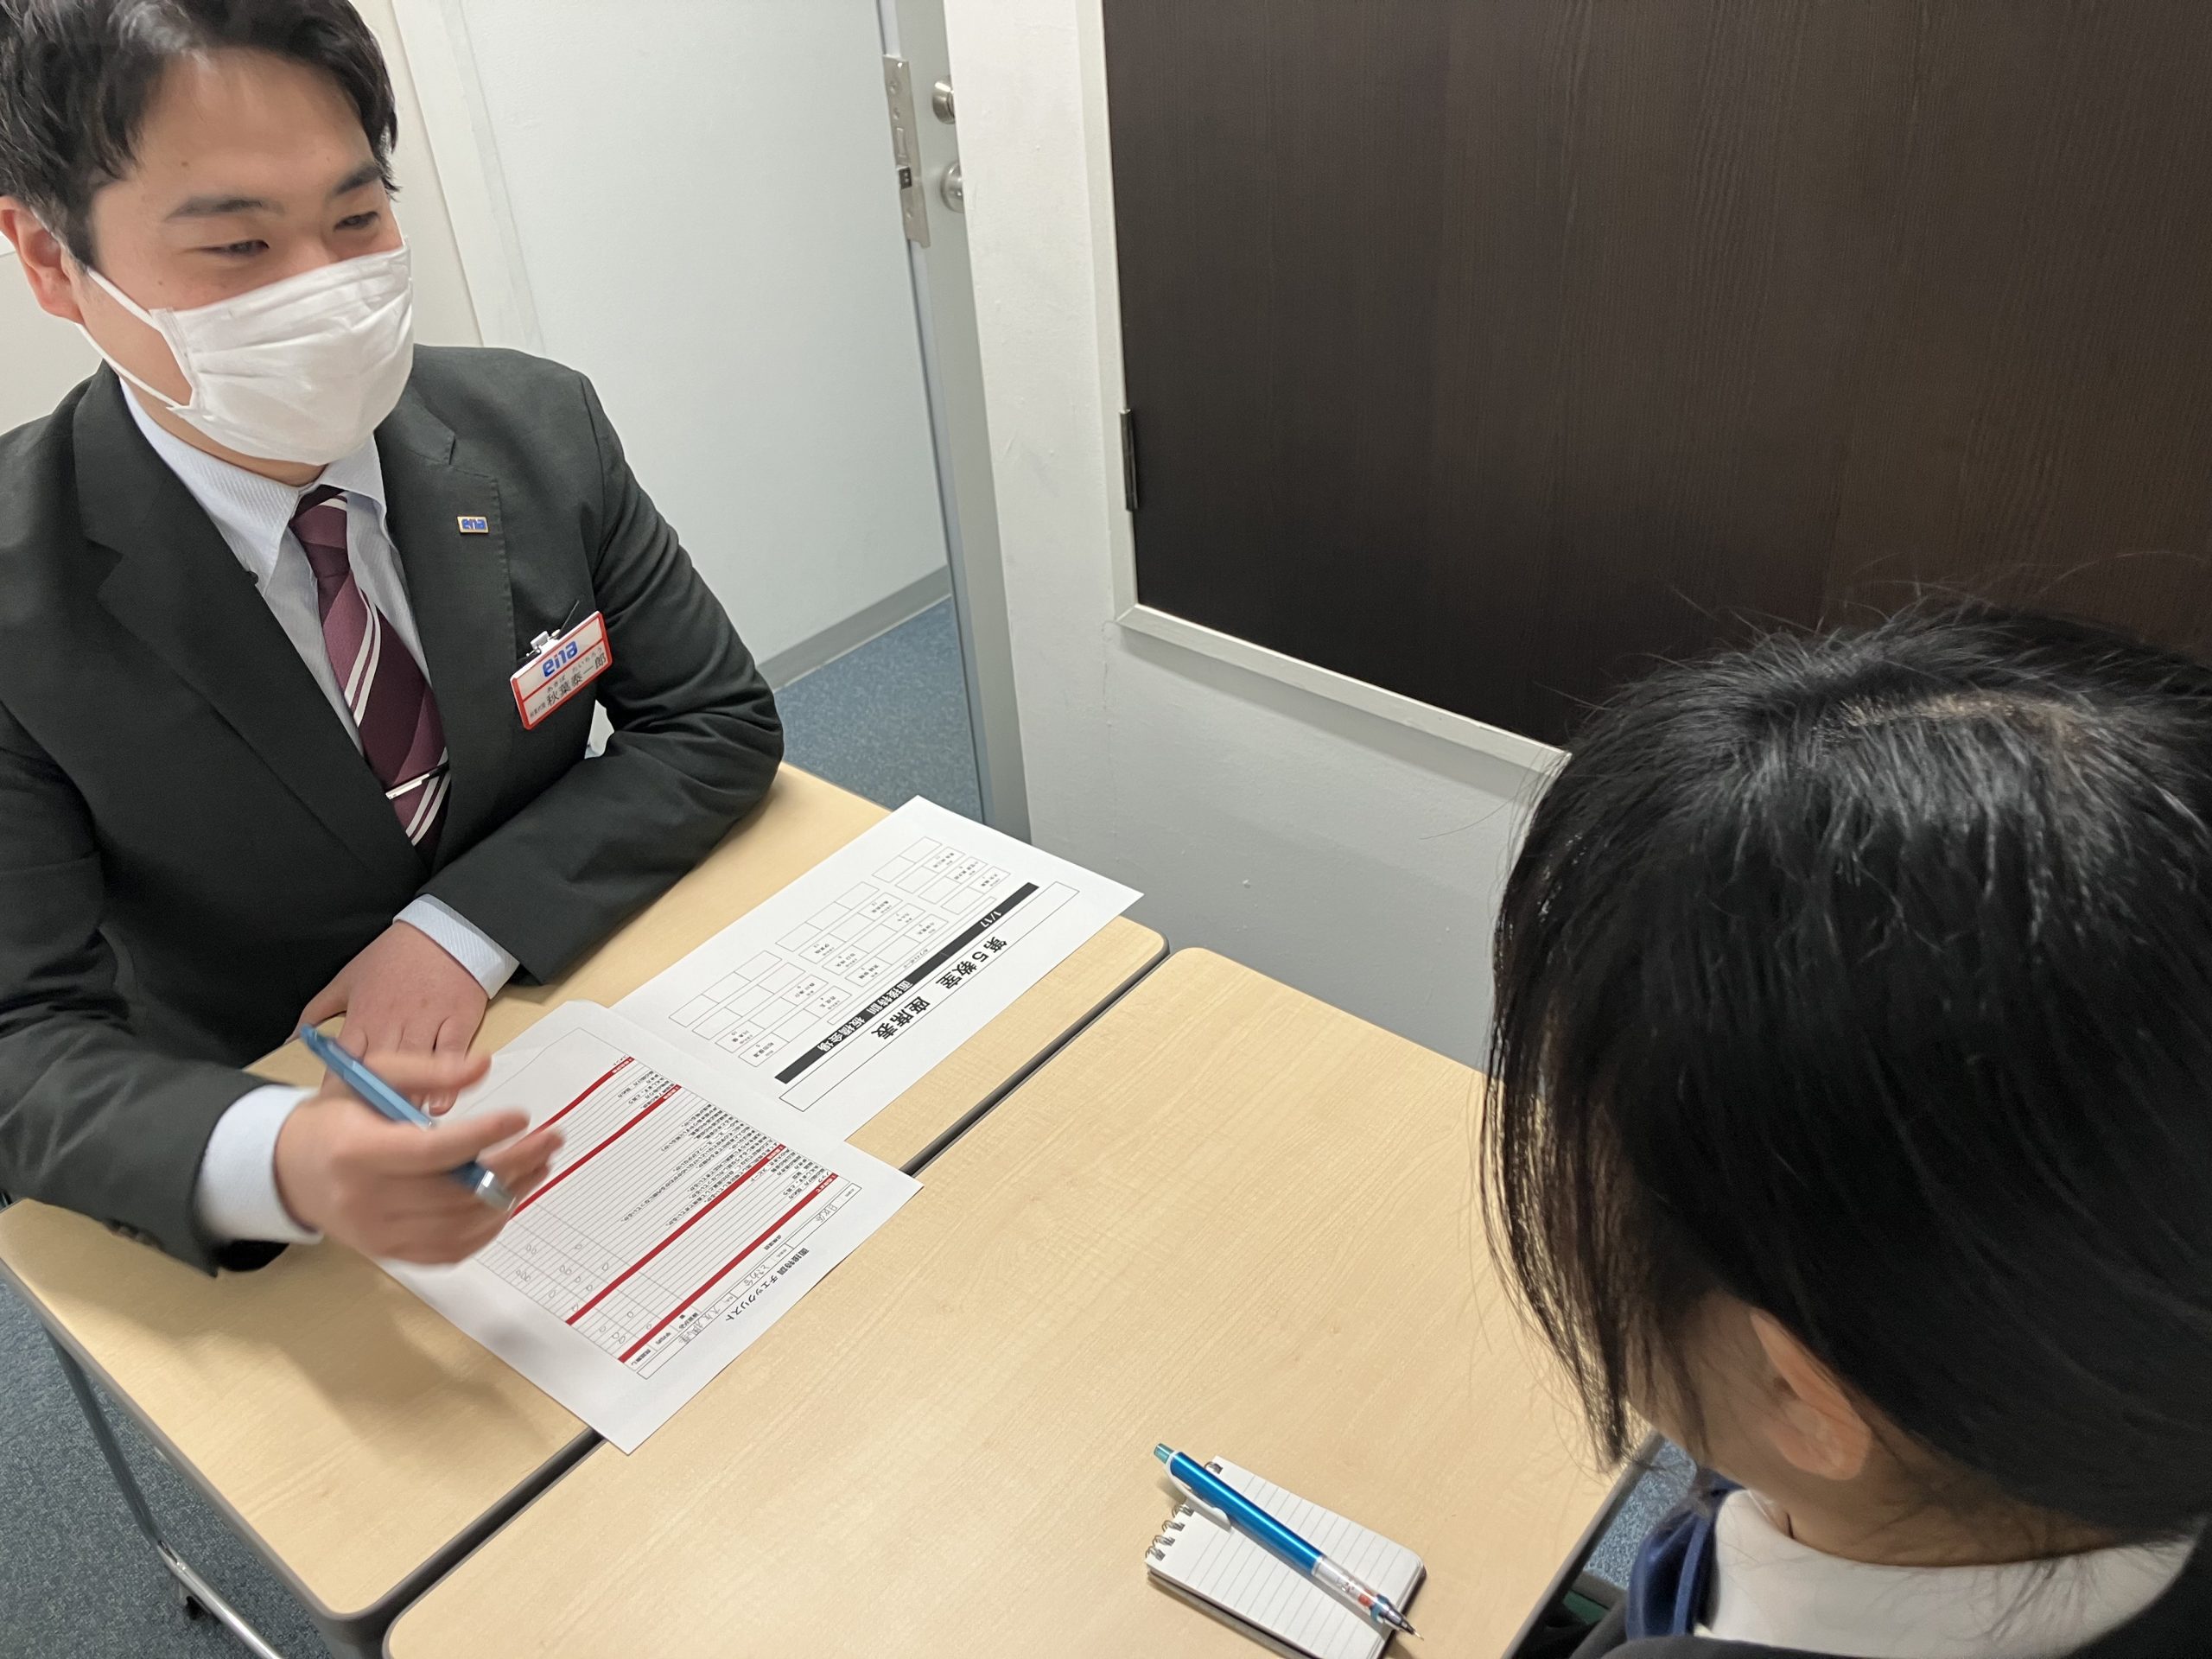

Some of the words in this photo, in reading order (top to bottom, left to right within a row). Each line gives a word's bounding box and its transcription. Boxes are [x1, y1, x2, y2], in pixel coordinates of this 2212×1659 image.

[542, 641, 579, 677] ena
[976, 910, 1003, 927] 1/17
[933, 935, 1008, 989] 第5教室
[864, 979, 913, 1014] 面接特訓
[816, 1015, 867, 1052] 板橋会場
[869, 995, 932, 1041] 座席表
[816, 1170, 830, 1183] ノック
[776, 1247, 809, 1275] 面接特訓
[723, 1274, 779, 1323] チェックリスト
